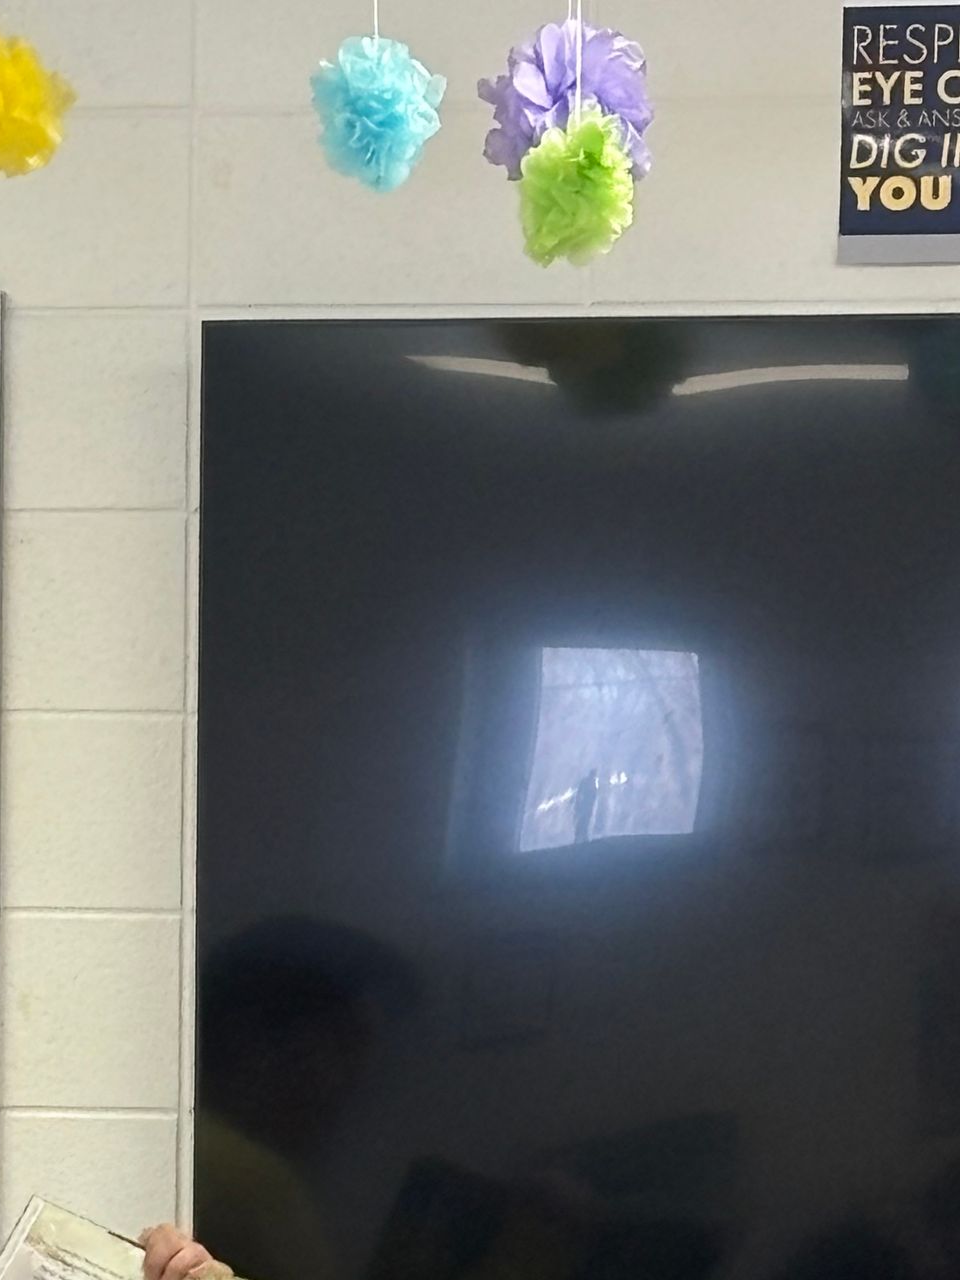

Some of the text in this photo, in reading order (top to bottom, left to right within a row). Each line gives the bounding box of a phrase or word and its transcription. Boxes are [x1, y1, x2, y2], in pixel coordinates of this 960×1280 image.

[852, 23, 960, 65] RESP
[852, 70, 924, 106] EYE
[851, 108, 960, 129] ASK & ANS
[849, 132, 960, 169] DIG I
[847, 174, 953, 211] YOU
